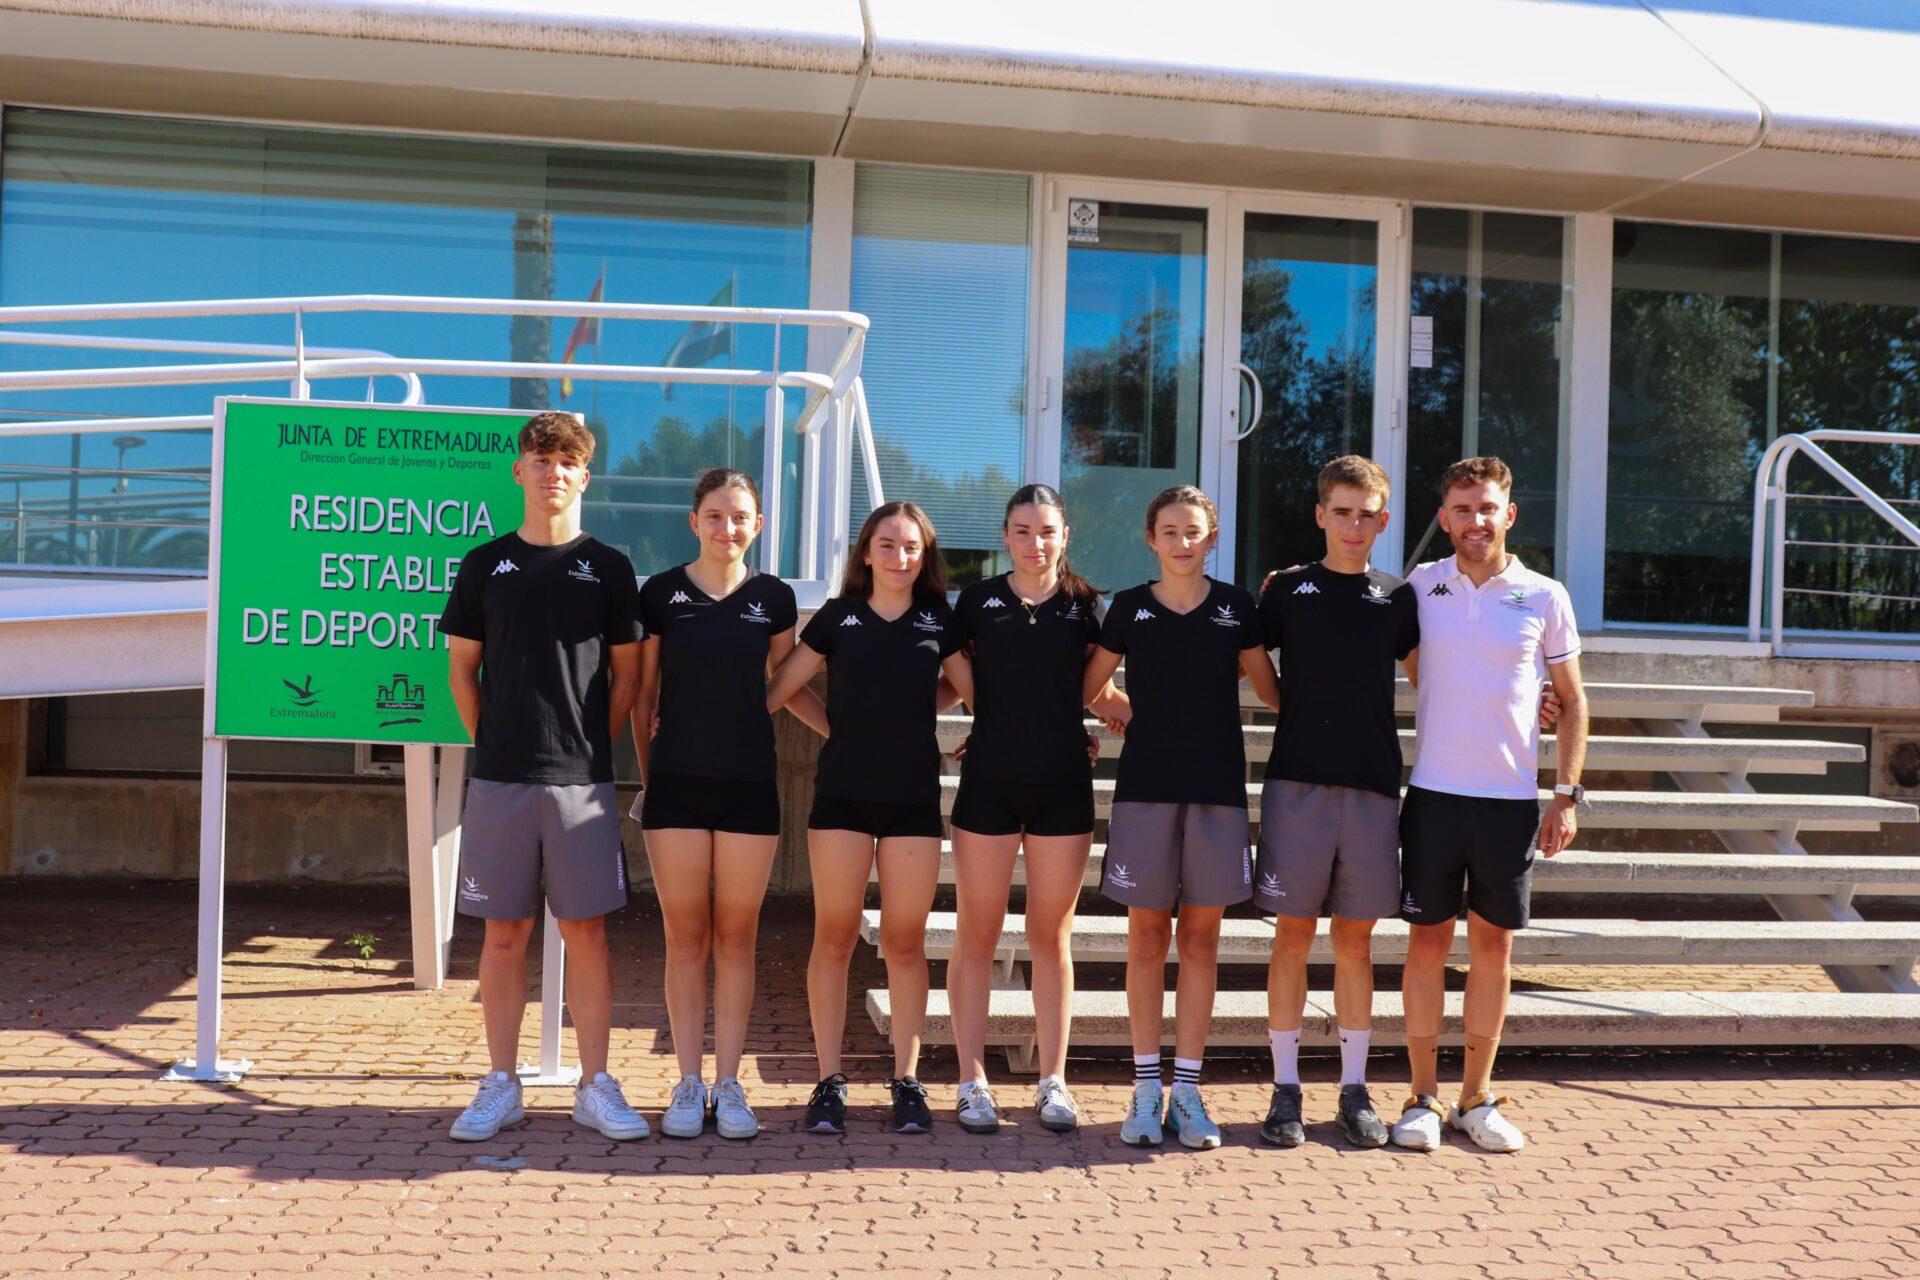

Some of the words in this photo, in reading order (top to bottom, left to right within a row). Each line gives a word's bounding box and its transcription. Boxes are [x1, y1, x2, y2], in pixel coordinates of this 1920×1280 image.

[277, 424, 333, 448] JUNTA
[345, 426, 367, 448] DE
[378, 428, 516, 454] EXTREMADURA
[300, 450, 345, 464] Dirección
[348, 452, 385, 466] General
[388, 454, 400, 466] de
[401, 454, 437, 469] Jóvenes
[440, 459, 445, 470] y
[448, 457, 492, 471] Deportes
[290, 493, 496, 538] RESIDENCIA
[320, 553, 463, 593] ESTABLE
[243, 608, 290, 645] DE
[301, 609, 450, 650] DEPORT
[269, 707, 337, 719] Extremadura
